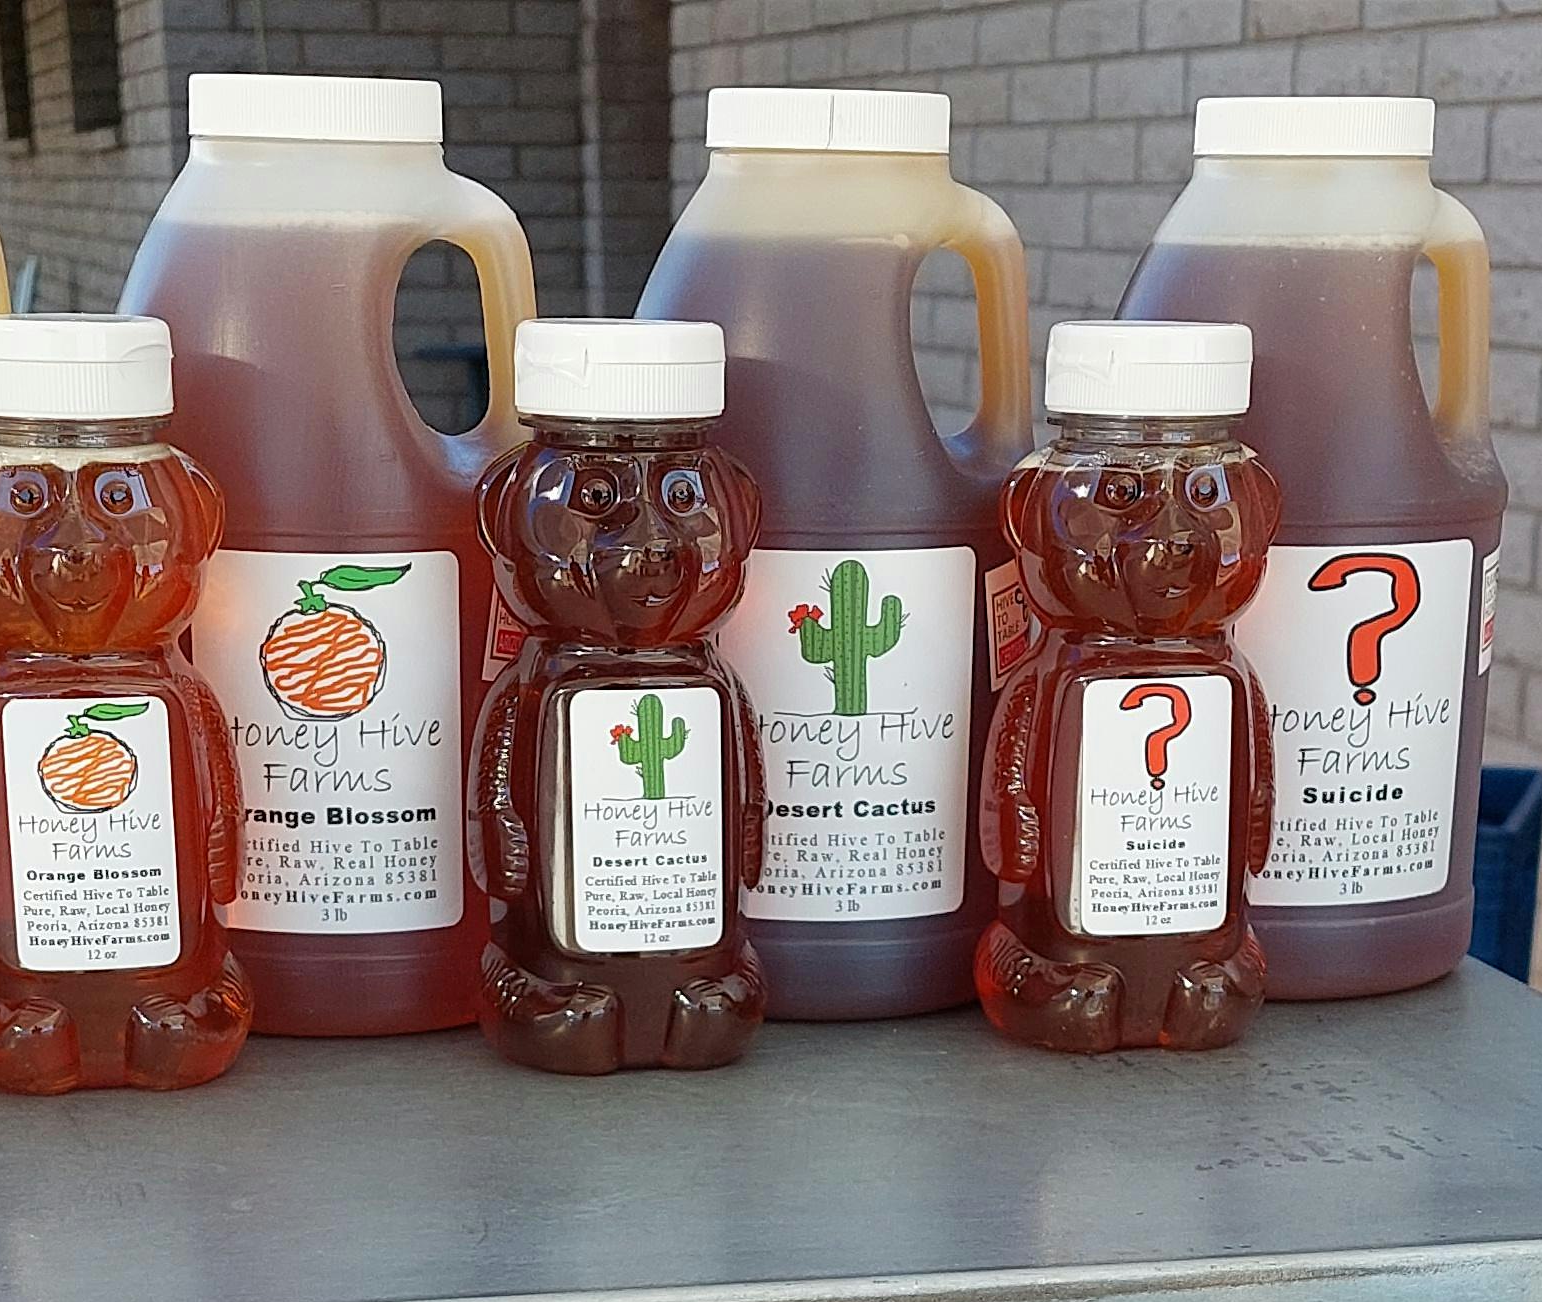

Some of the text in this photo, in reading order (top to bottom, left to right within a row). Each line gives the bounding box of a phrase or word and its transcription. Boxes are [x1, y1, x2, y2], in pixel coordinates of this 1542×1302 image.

[1389, 693, 1450, 728] Hive
[359, 713, 441, 749] Hive
[881, 713, 954, 743] Hive
[1298, 748, 1409, 776] Farms
[263, 763, 392, 793] Farms
[786, 760, 908, 788] Farms
[1091, 782, 1218, 815] Honey Hive
[1303, 785, 1403, 804] Suicide
[584, 799, 713, 829] Honey Hive
[854, 798, 936, 816] Cactus
[19, 810, 160, 843] Honey Hive
[245, 807, 436, 828] range Blossom
[1121, 815, 1192, 832] Farms
[615, 830, 687, 847] Farms
[1126, 840, 1185, 850] Suicide
[1301, 826, 1439, 847] Raw, Local Honey
[53, 843, 131, 860] Farms
[593, 854, 708, 867] Desert Cactus
[1089, 854, 1220, 870] Certified Hive To Table
[27, 868, 161, 883] Orange Blossom
[1340, 882, 1362, 895] 3 lb
[835, 900, 859, 912] 3 lb
[27, 921, 71, 932] Peoria,
[78, 920, 129, 931] Arizona
[590, 917, 715, 932] HoneyHiveFarms.com
